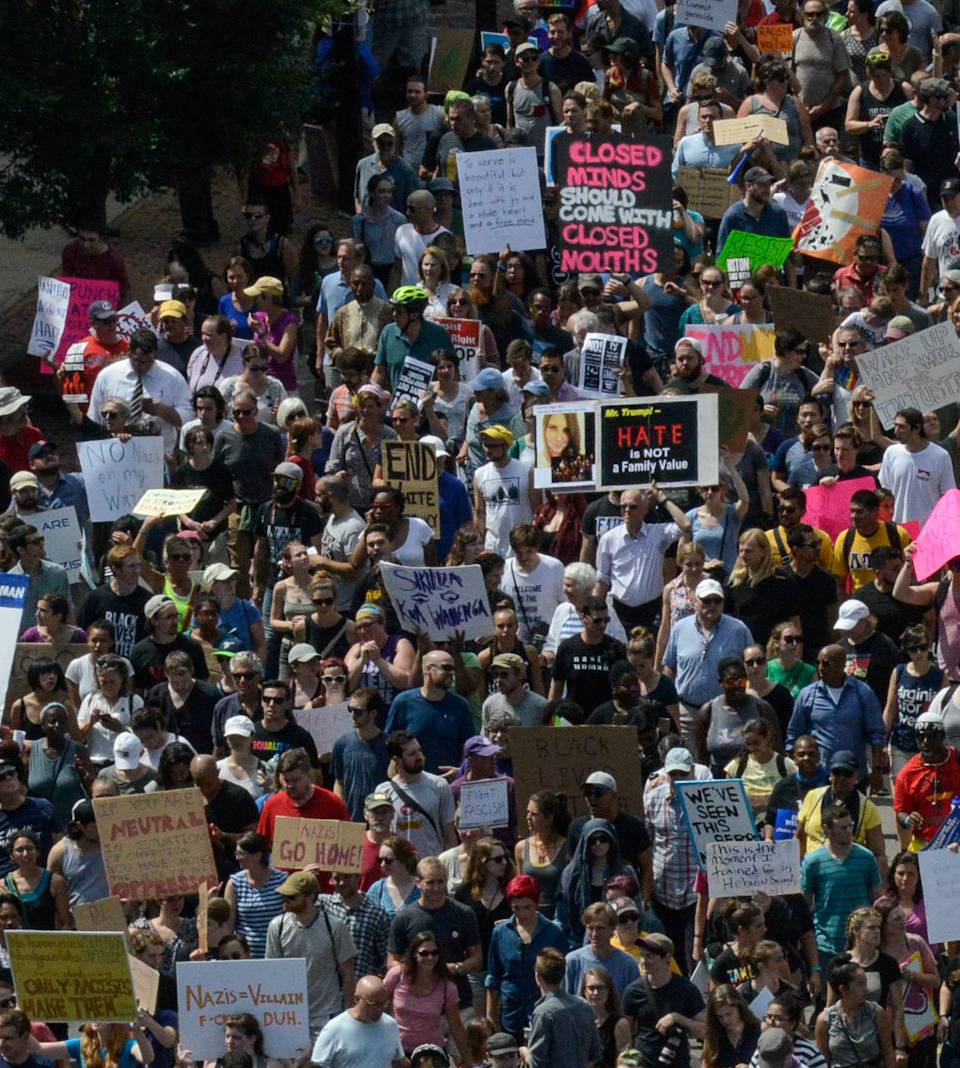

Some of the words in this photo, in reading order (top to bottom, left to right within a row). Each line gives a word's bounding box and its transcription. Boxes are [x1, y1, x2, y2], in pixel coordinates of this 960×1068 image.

[570, 142, 663, 166] CLOSED
[567, 168, 645, 191] MINDS
[560, 187, 636, 208] SHOULD
[559, 206, 616, 223] COME
[618, 209, 672, 229] WITH
[563, 225, 648, 249] CLOSED
[562, 248, 658, 273] MOUTHS
[858, 341, 920, 375] WAKE
[920, 326, 949, 349] UP
[628, 408, 652, 417] Trump!
[617, 424, 684, 448] HATE
[87, 441, 126, 467] NO
[384, 445, 435, 482] END
[629, 449, 641, 459] is
[641, 448, 671, 458] NOT
[612, 464, 620, 473] a
[621, 460, 657, 474] Family
[658, 458, 689, 471] Value
[42, 518, 71, 532] ARE
[105, 611, 139, 627] BLACK
[537, 737, 609, 756] BLACK
[685, 787, 739, 804] WE'VE
[697, 806, 739, 821] SEEN
[110, 811, 203, 841] NEUTRAL
[692, 821, 731, 836] THIS
[279, 839, 304, 863] GO
[315, 841, 363, 867] HOME!
[711, 855, 757, 866] moment
[24, 978, 70, 995] ONLY
[23, 1000, 67, 1018] MAKE
[73, 998, 118, 1019] THEM
[263, 1011, 302, 1025] DUH.
